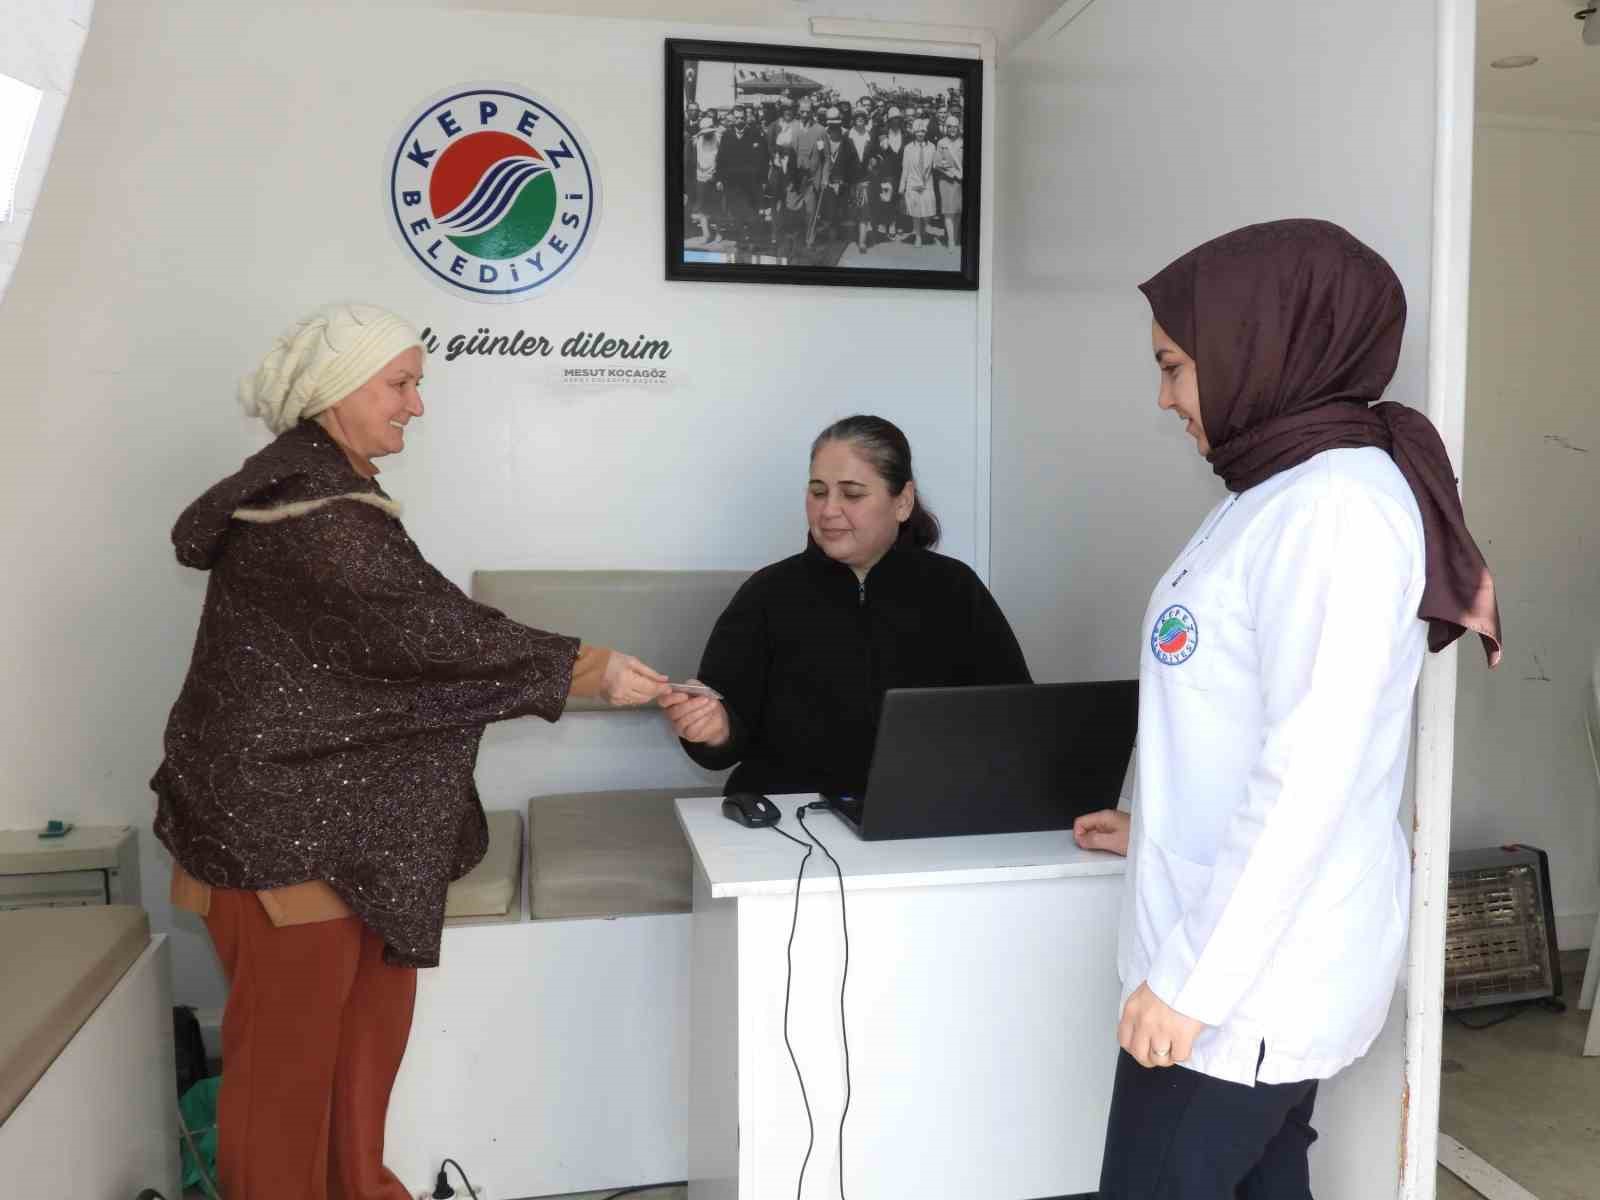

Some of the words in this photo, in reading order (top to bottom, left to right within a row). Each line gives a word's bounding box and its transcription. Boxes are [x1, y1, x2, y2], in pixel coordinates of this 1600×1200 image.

[406, 101, 575, 168] KEPEZ
[445, 328, 553, 361] günler
[561, 331, 672, 359] dilerim
[564, 368, 606, 377] MESUT
[608, 368, 667, 378] KOCAGÖZ
